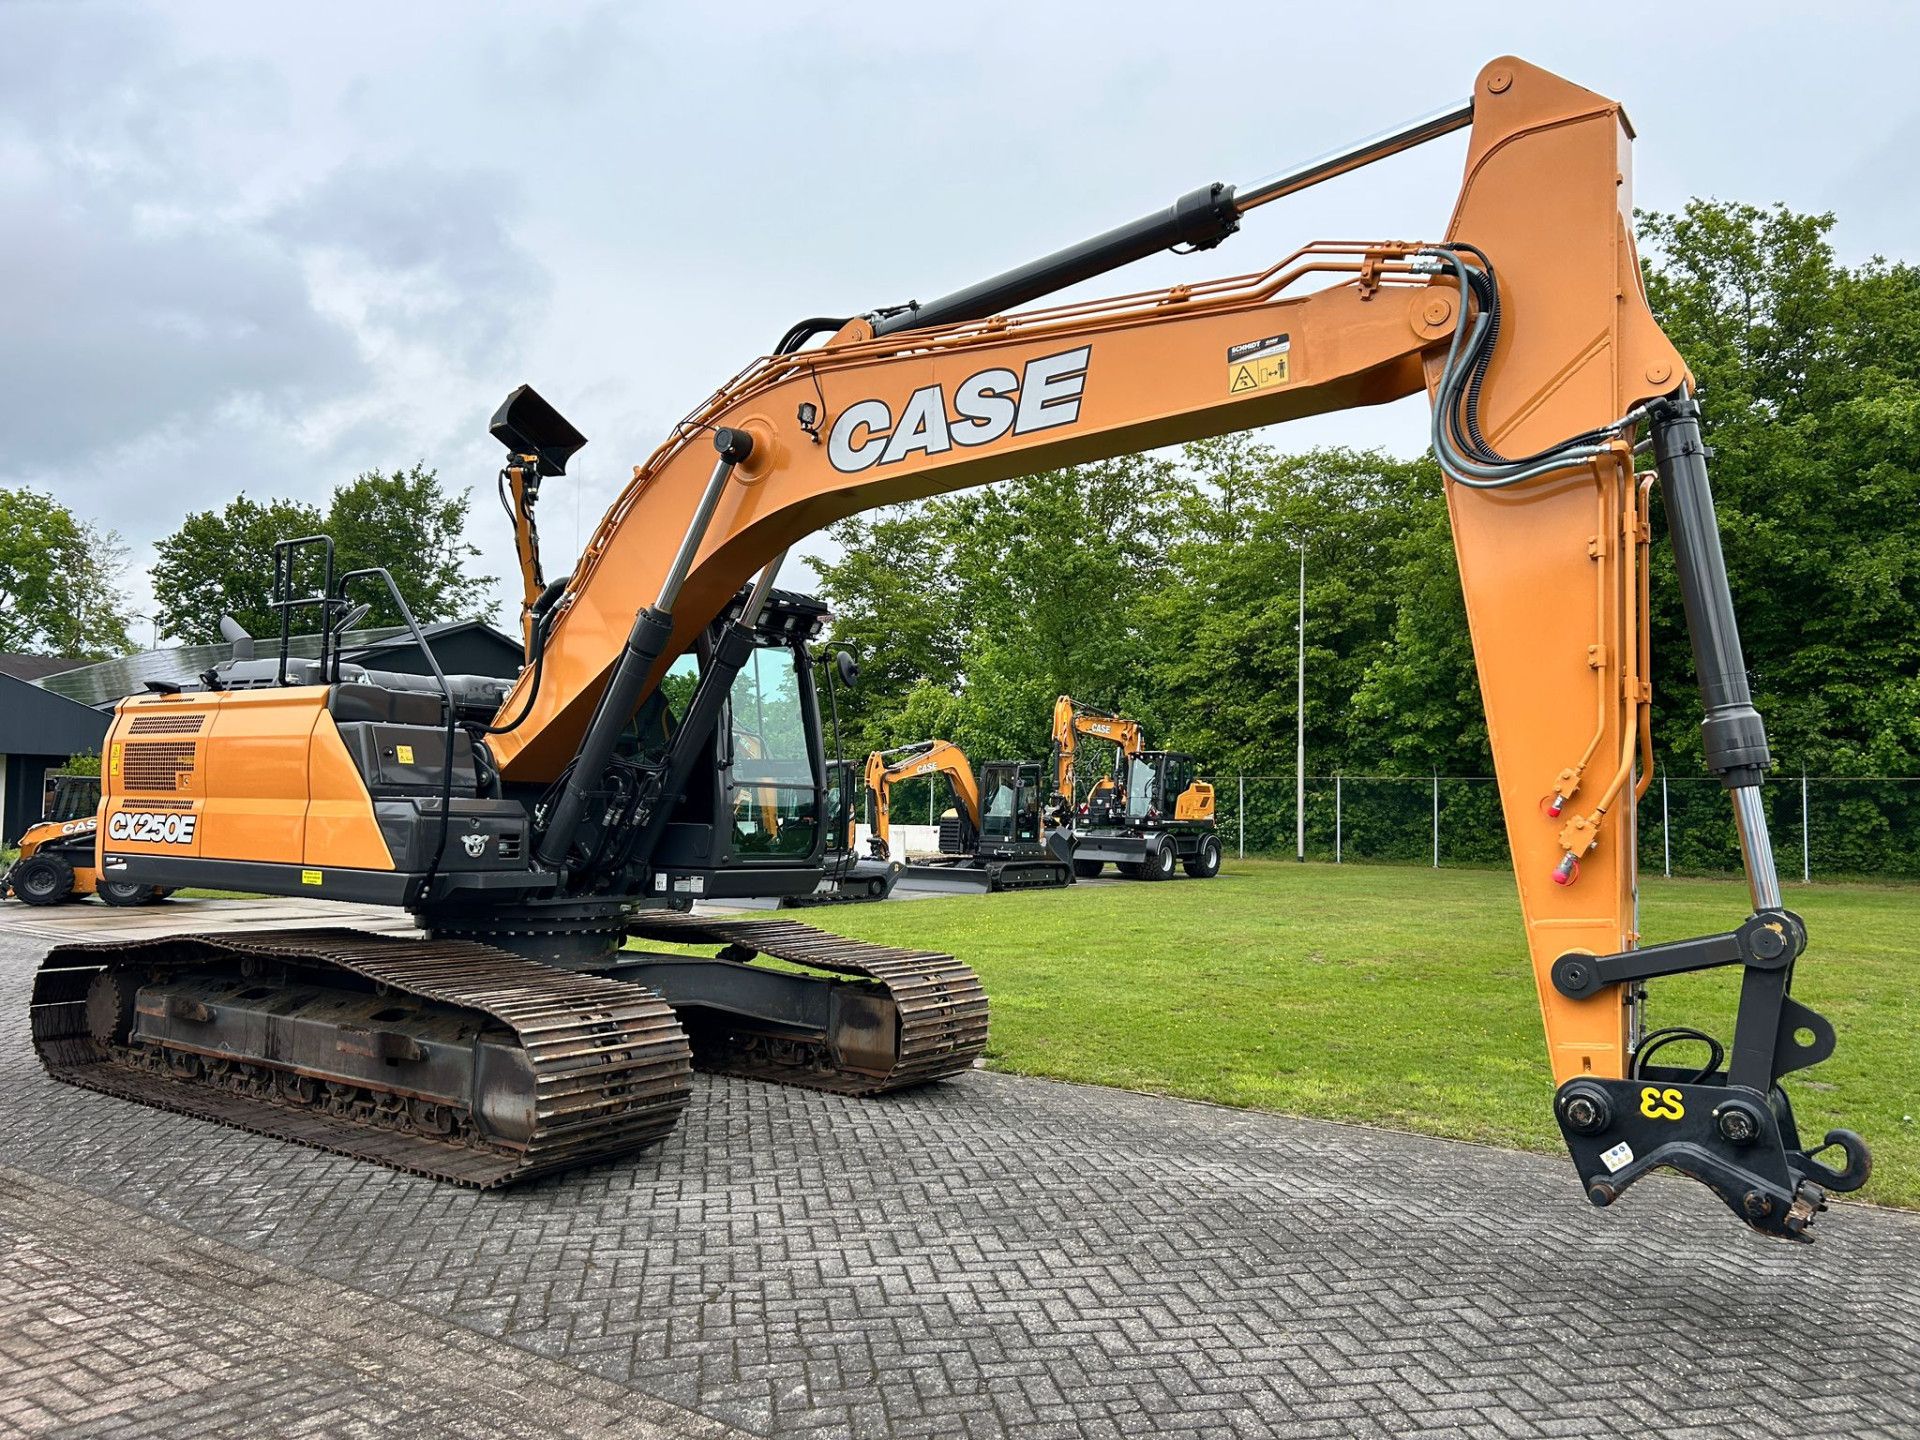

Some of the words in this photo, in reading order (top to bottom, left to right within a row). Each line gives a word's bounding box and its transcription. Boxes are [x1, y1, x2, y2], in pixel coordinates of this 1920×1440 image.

[827, 343, 1092, 474] CASE
[1092, 724, 1111, 734] CASE
[917, 762, 937, 773] CASE
[62, 820, 97, 834] CAS
[108, 811, 197, 844] CX250E
